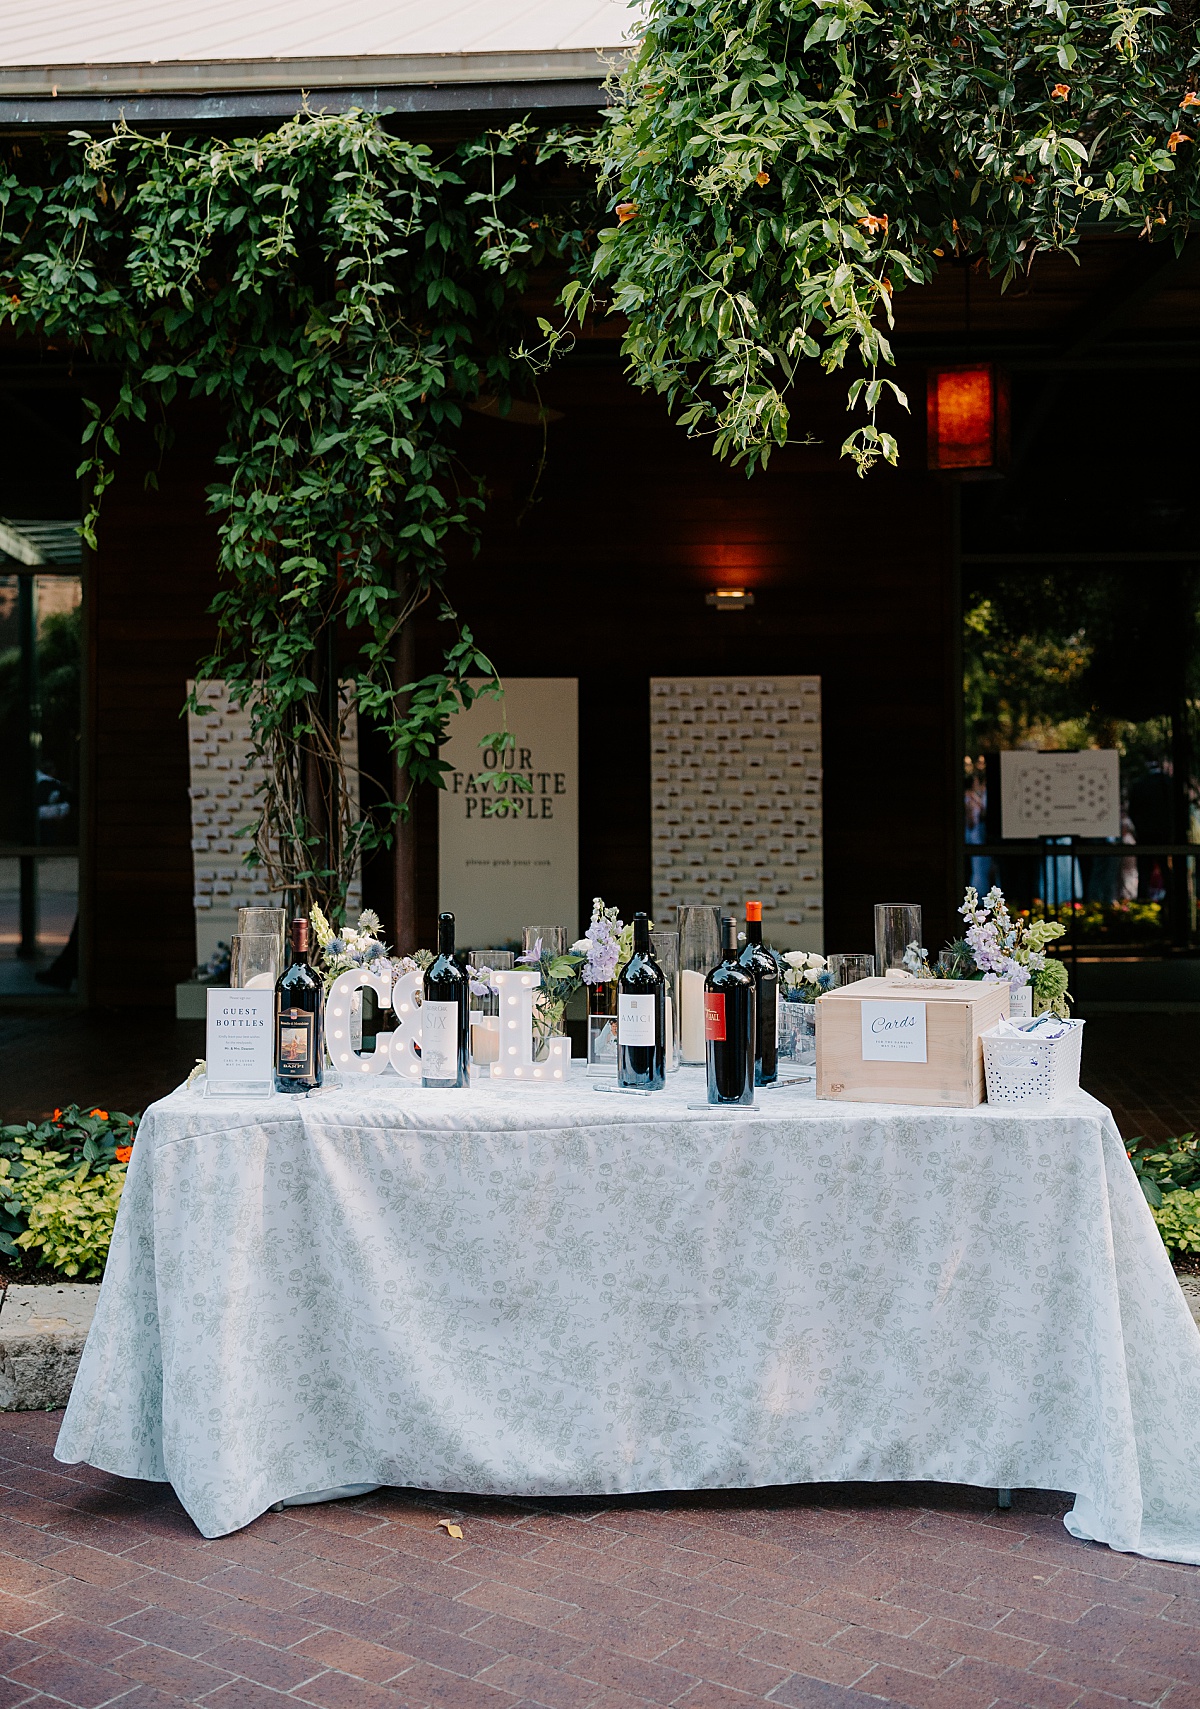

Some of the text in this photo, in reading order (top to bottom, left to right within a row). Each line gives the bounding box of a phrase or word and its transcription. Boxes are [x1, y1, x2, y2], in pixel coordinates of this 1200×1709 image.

[483, 747, 533, 770] OUR
[453, 772, 566, 794] FAVORITE
[465, 797, 553, 819] PEOPLE
[426, 1013, 447, 1029] SIX
[621, 1014, 651, 1023] AMICI
[871, 1016, 917, 1034] Cards
